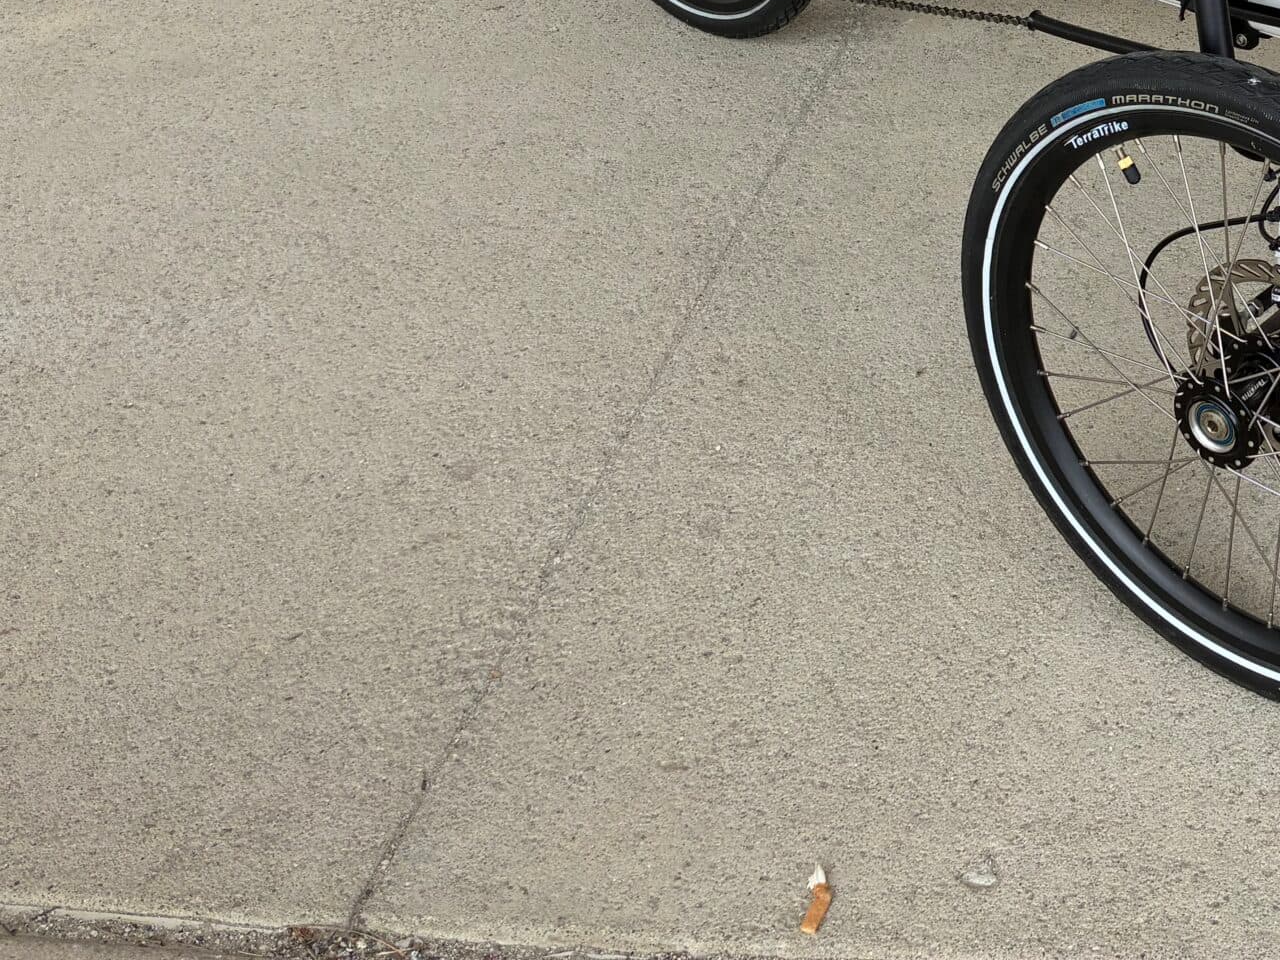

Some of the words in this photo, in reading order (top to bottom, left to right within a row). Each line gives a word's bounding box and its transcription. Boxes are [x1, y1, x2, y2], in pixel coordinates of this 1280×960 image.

[991, 123, 1048, 191] SCHWALBE
[1111, 93, 1219, 114] MARATHON
[1064, 119, 1129, 150] TerraTrike
